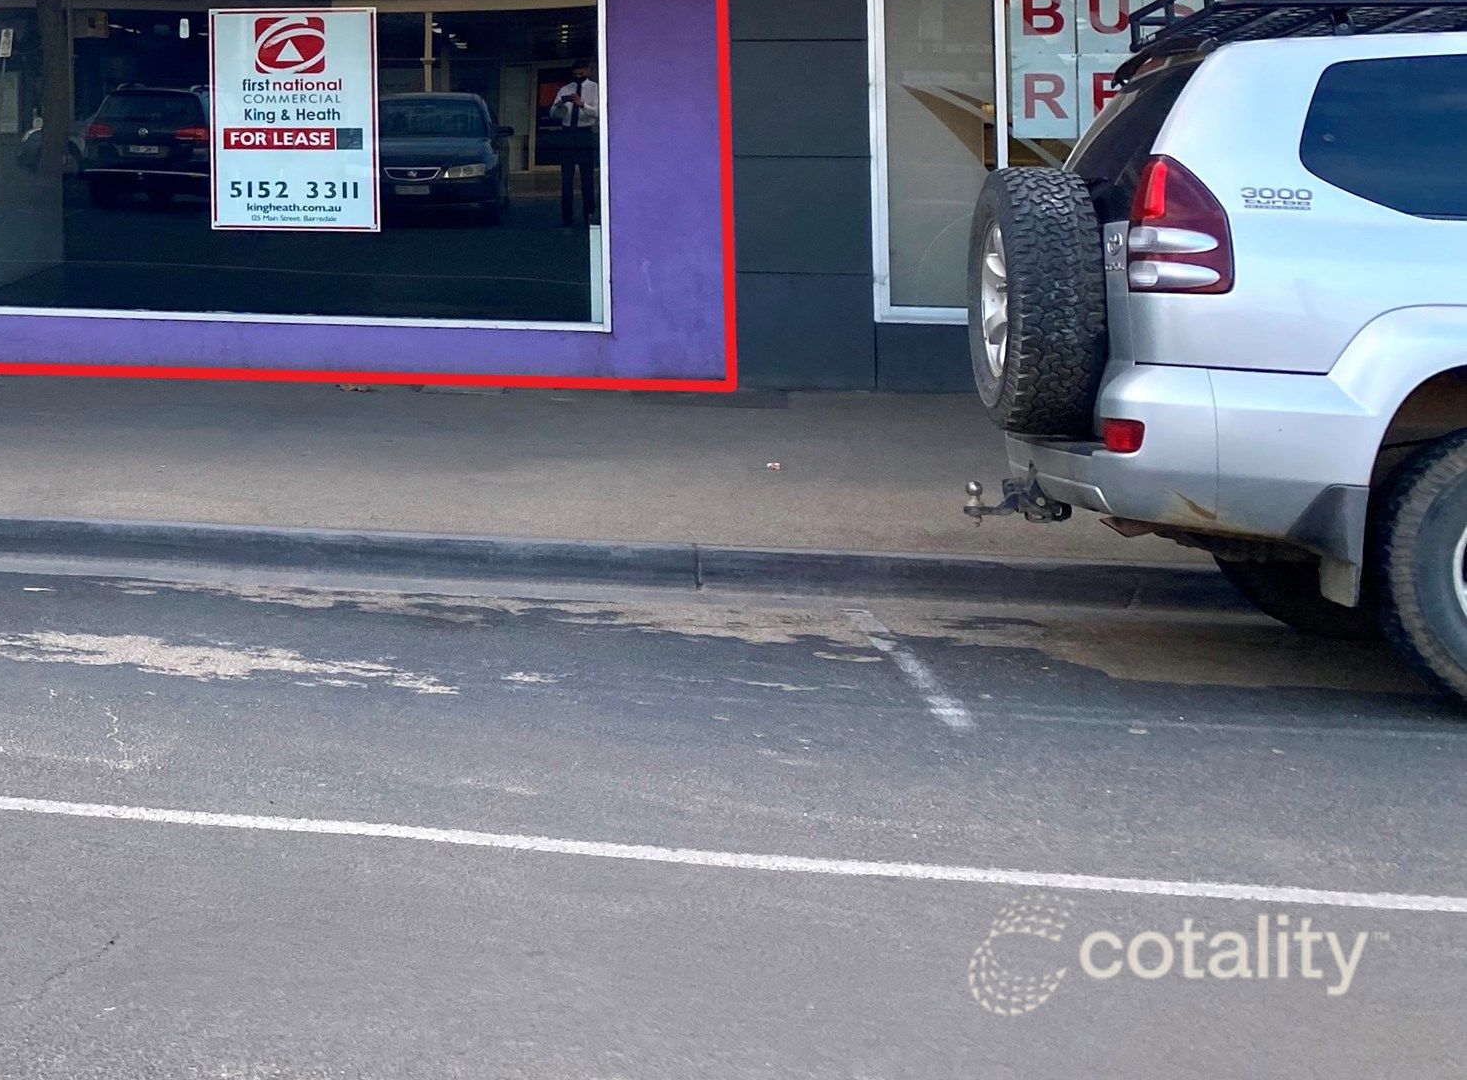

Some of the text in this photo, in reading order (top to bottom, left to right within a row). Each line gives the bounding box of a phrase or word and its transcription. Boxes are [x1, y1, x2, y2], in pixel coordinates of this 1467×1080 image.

[242, 78, 343, 91] first national
[243, 94, 342, 104] COMMERCIAL
[244, 108, 341, 123] King & Heath
[230, 132, 331, 146] FOR LEASE
[230, 181, 359, 199] 5152 3311
[1240, 187, 1313, 200] 3000
[246, 203, 342, 214] kingheath.com.au
